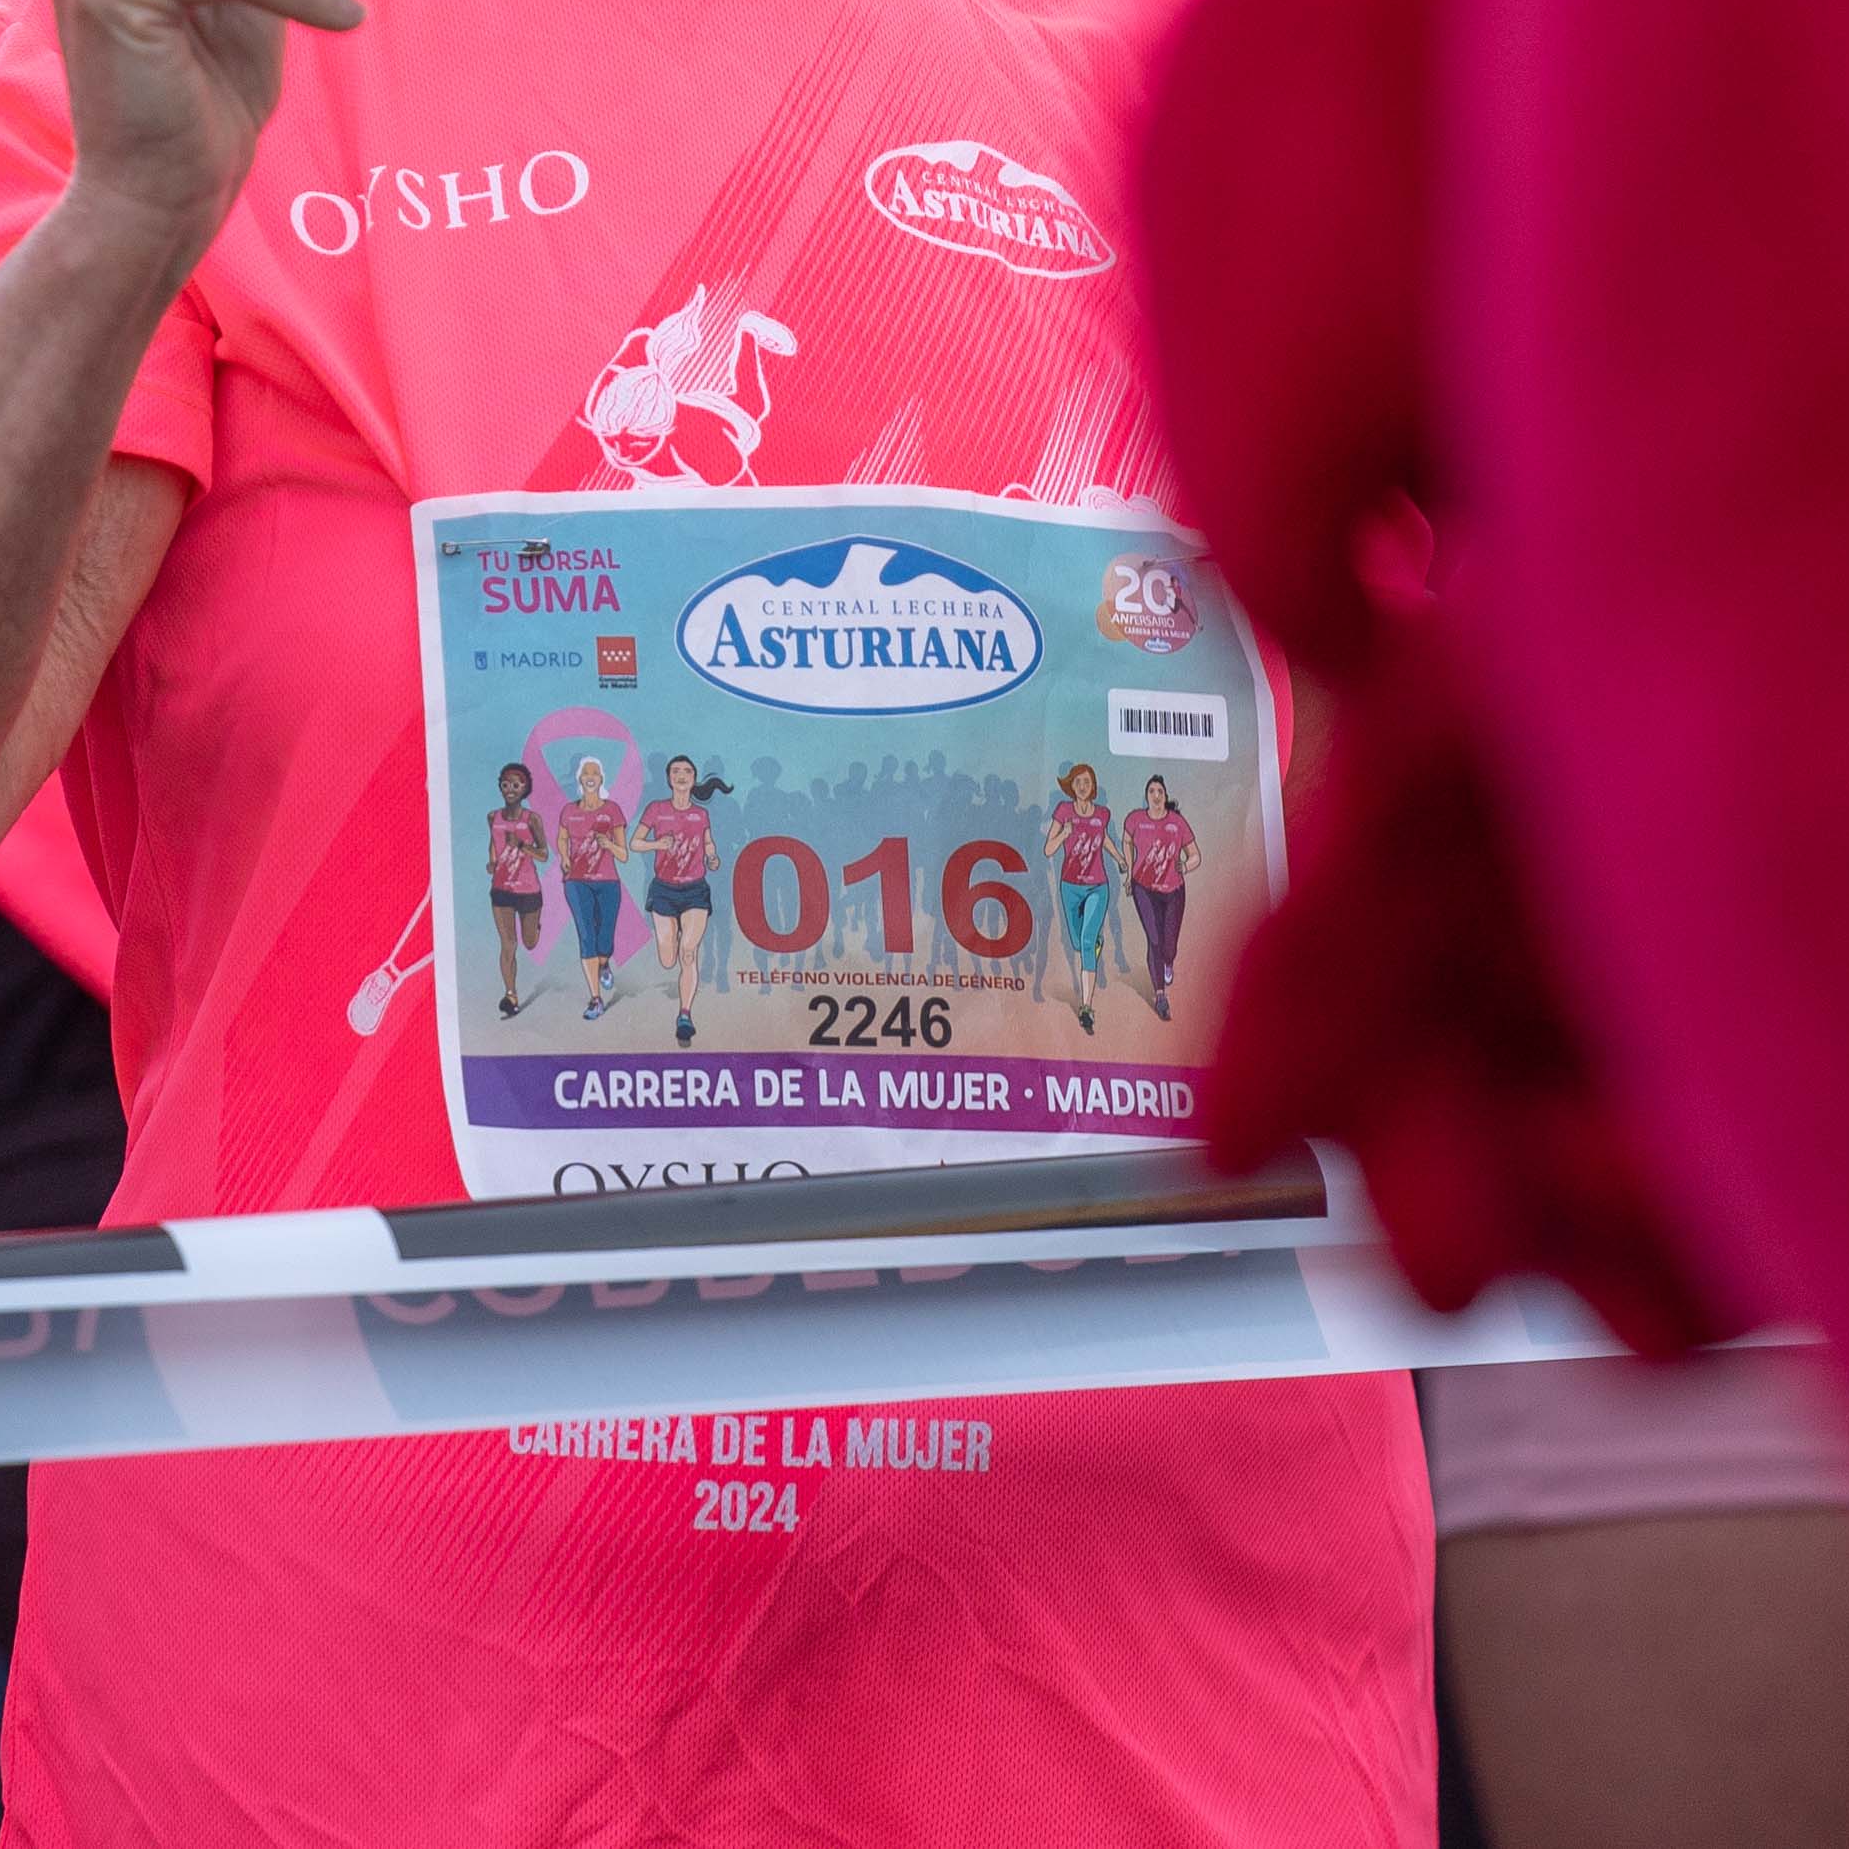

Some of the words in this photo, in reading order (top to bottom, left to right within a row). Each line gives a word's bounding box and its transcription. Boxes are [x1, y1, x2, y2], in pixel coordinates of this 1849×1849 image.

[290, 150, 590, 255] OYSHO
[888, 169, 1101, 261] ASTURIANA
[477, 550, 510, 572] TU
[517, 547, 621, 573] DORSAL
[482, 574, 621, 614] SUMA
[761, 600, 880, 616] CENTRAL
[892, 600, 1005, 620] LECHERA
[1114, 565, 1176, 616] 20
[500, 651, 583, 669] MADRID
[706, 603, 1018, 673] ASTURIANA
[731, 835, 1034, 959] 016
[736, 968, 831, 986] TELÉFONO
[834, 972, 929, 988] VIOLENCIA
[933, 973, 955, 988] DE
[807, 994, 953, 1048] 2246
[553, 1068, 741, 1110] CARRERA
[754, 1068, 804, 1108] DE
[817, 1068, 866, 1109] LA
[878, 1070, 1011, 1112] MUJER
[1045, 1074, 1196, 1120] MADRID
[508, 1414, 698, 1465] CARRERA
[710, 1414, 767, 1466] DE
[780, 1415, 833, 1469] LA
[844, 1416, 993, 1473] MUJER
[692, 1480, 800, 1534] 2024
